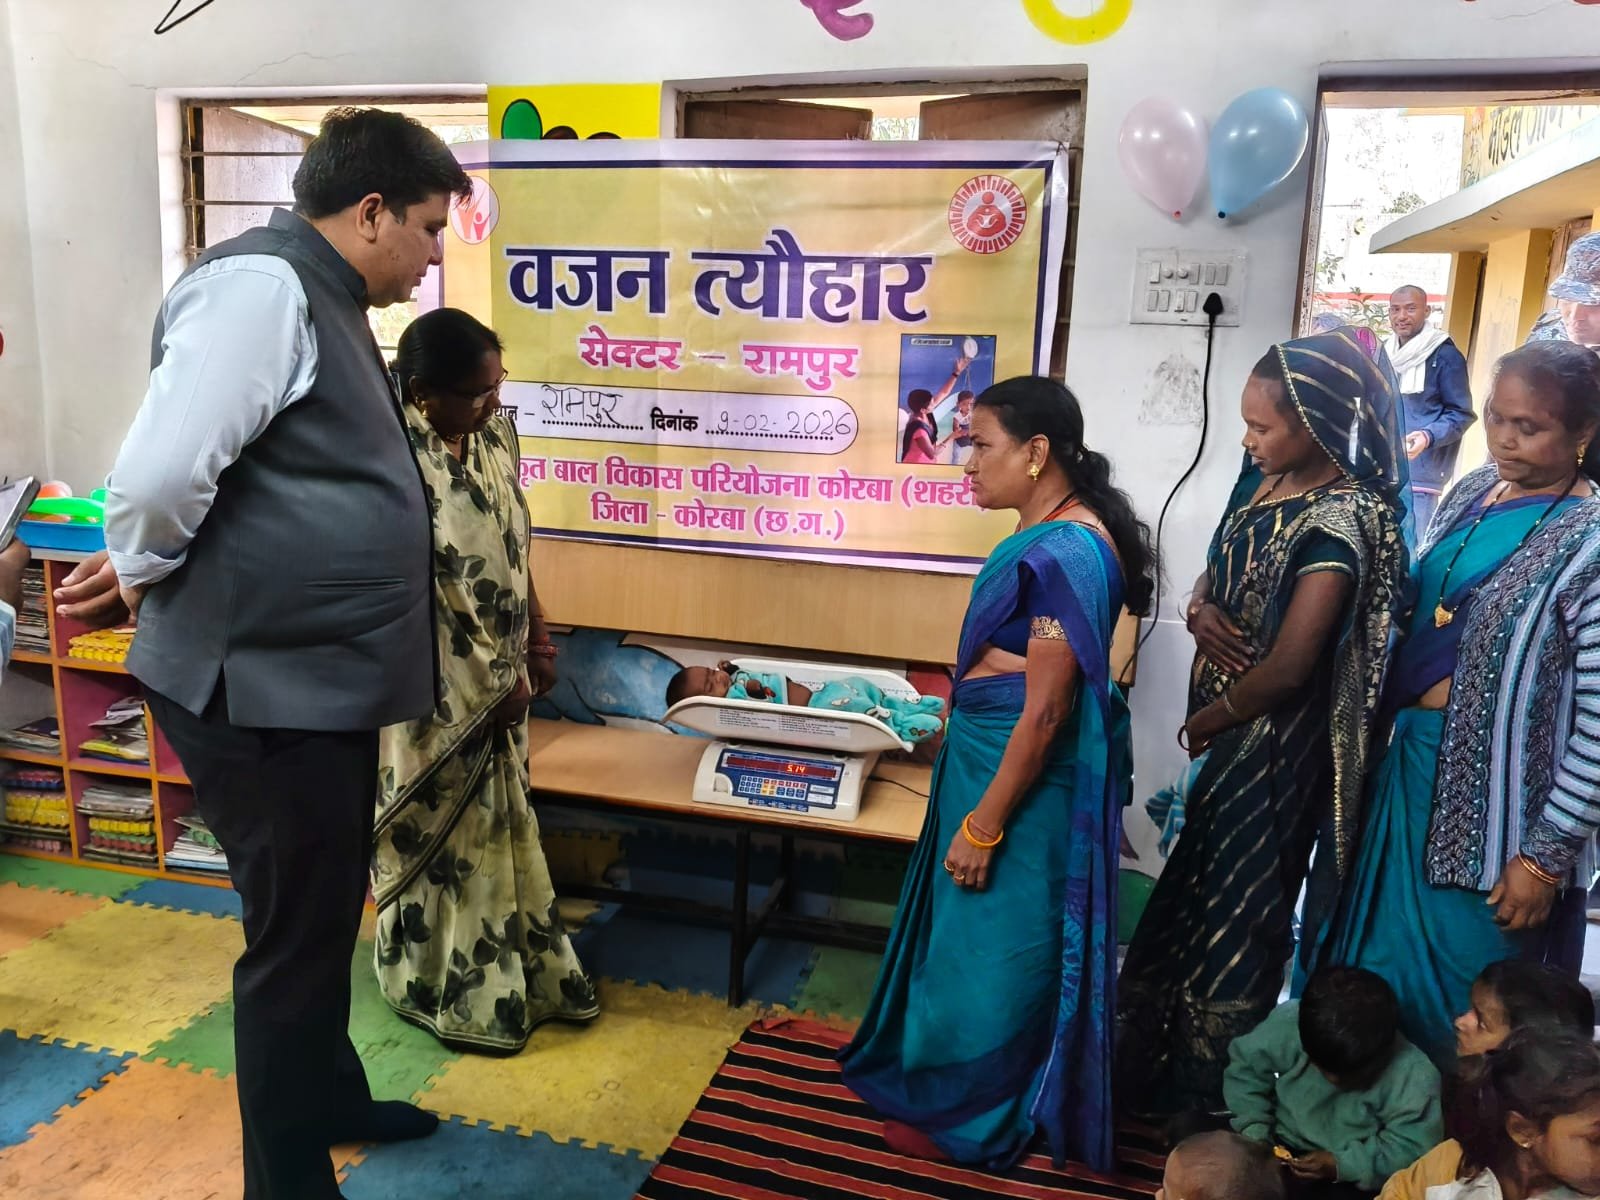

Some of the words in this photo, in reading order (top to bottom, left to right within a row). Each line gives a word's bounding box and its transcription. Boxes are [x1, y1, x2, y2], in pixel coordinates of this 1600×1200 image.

[506, 248, 669, 313] वजन
[692, 229, 932, 323] त्यौहार
[579, 325, 682, 370] सेक्टर
[743, 345, 859, 391] रामपुर
[541, 384, 622, 426] रामपुर
[650, 407, 699, 433] दिनांक
[553, 459, 599, 485] बाल
[604, 456, 684, 491] विकास
[690, 462, 810, 497] परियोजना
[818, 470, 893, 503] कोरबा
[590, 491, 649, 524] जिला
[674, 498, 746, 531] कोरबा
[754, 506, 845, 541] (छ.ग.)
